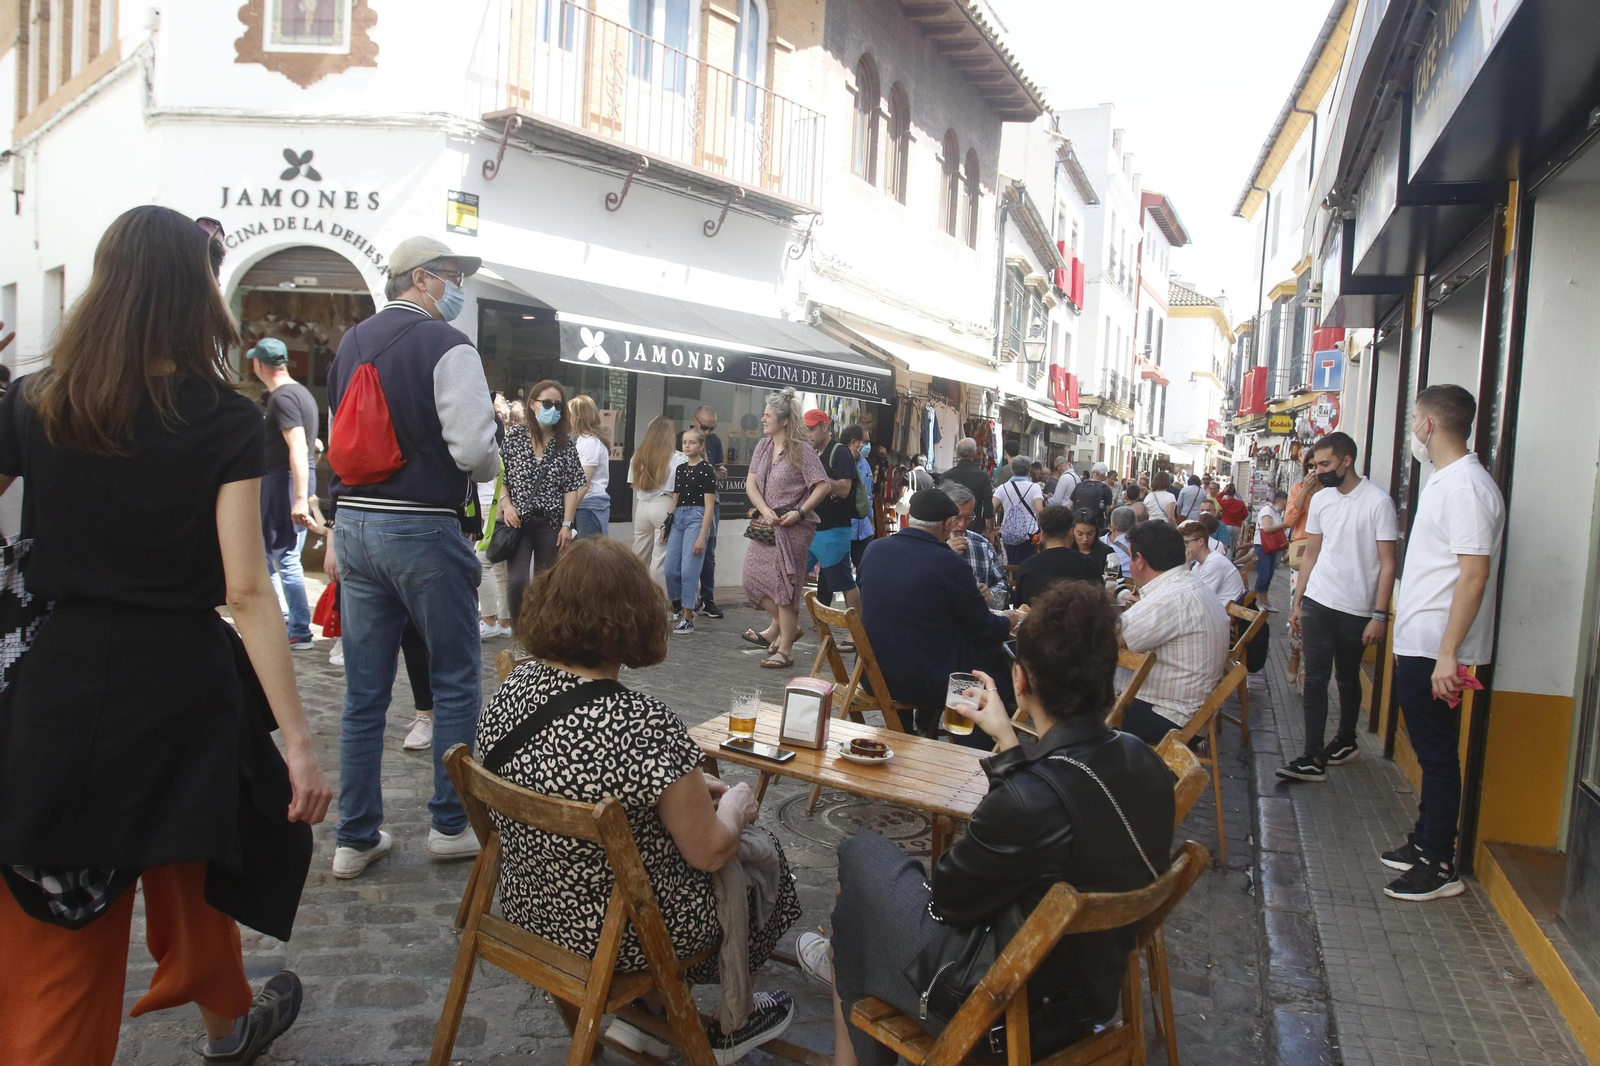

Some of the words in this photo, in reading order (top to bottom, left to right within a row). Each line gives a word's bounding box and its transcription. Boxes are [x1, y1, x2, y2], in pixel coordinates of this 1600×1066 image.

[1416, 25, 1437, 106] CAFÉ
[221, 187, 380, 211] JAMONES
[273, 216, 297, 231] DE
[302, 217, 324, 233] LA
[329, 222, 389, 276] DEHESA
[623, 340, 725, 373] JAMONES
[750, 361, 798, 382] ENCINA
[801, 369, 818, 385] DE
[820, 372, 835, 388] LA
[837, 375, 878, 395] DEHESA
